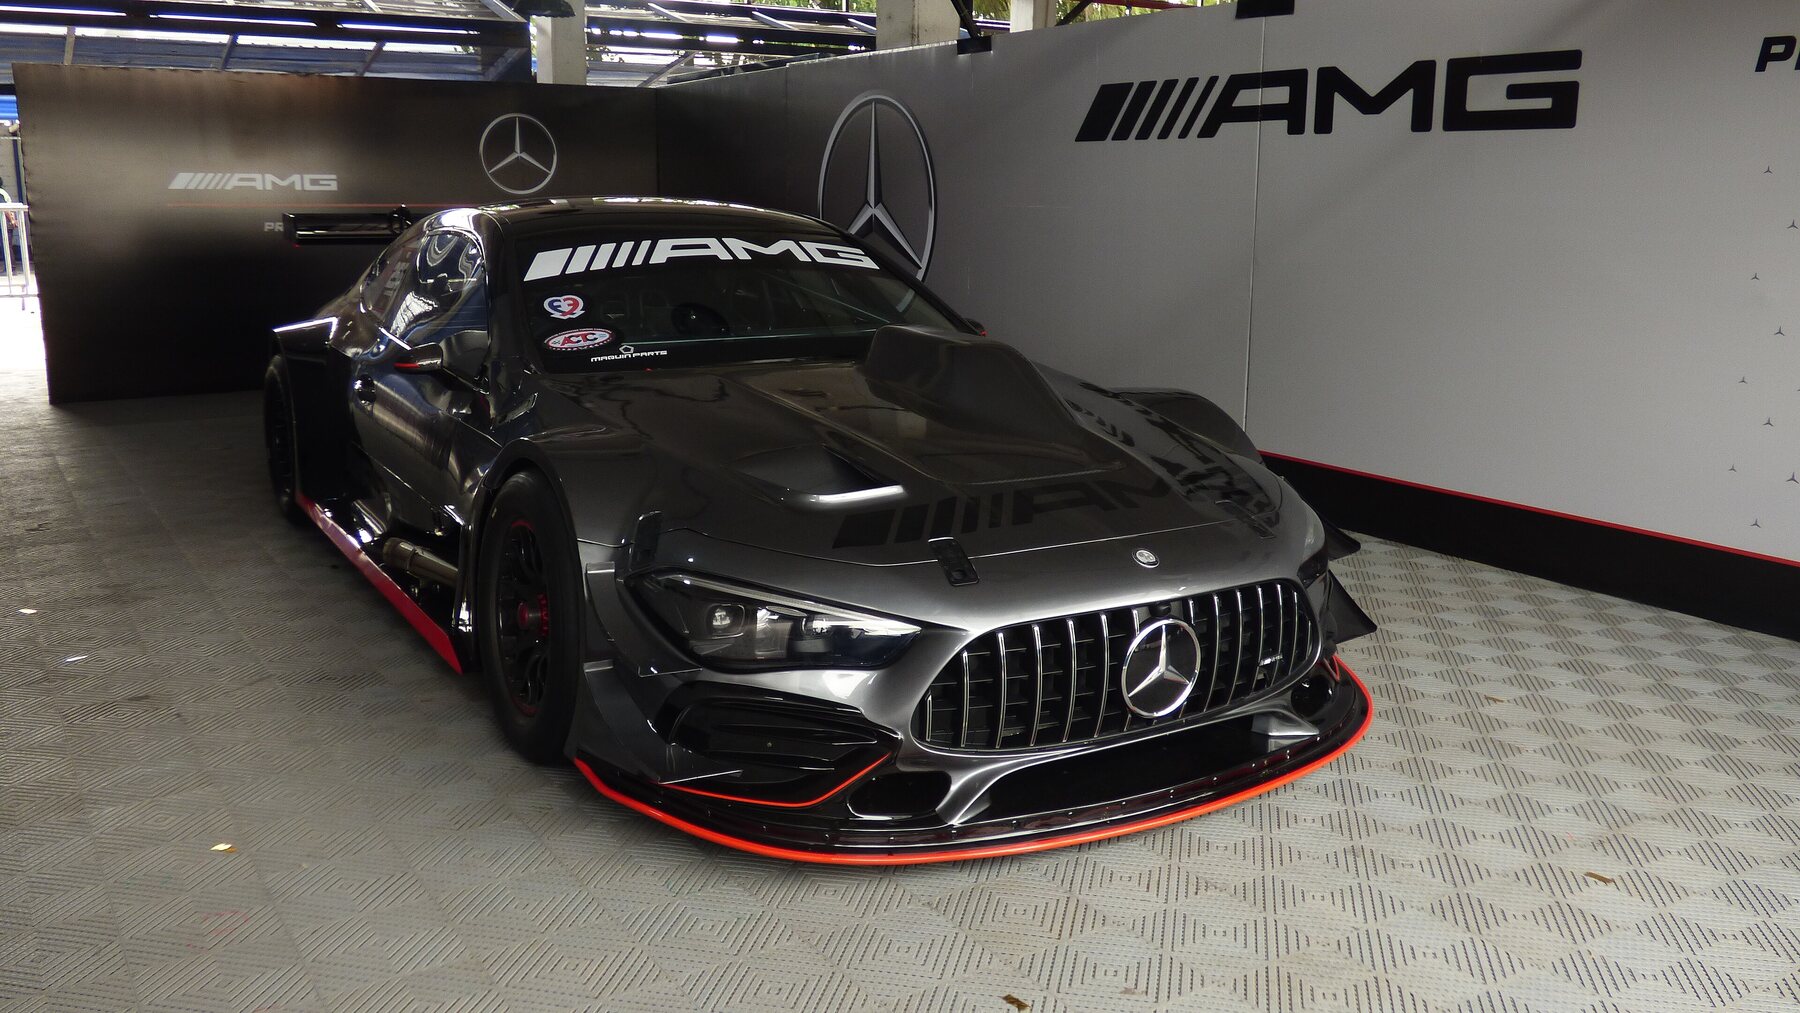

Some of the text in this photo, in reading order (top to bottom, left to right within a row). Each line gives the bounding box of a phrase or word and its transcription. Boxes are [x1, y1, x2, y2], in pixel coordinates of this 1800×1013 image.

[1754, 35, 1800, 72] P
[1197, 49, 1583, 138] AMG
[224, 173, 338, 191] AMG
[649, 238, 880, 269] AMG
[632, 350, 668, 358] PARTS
